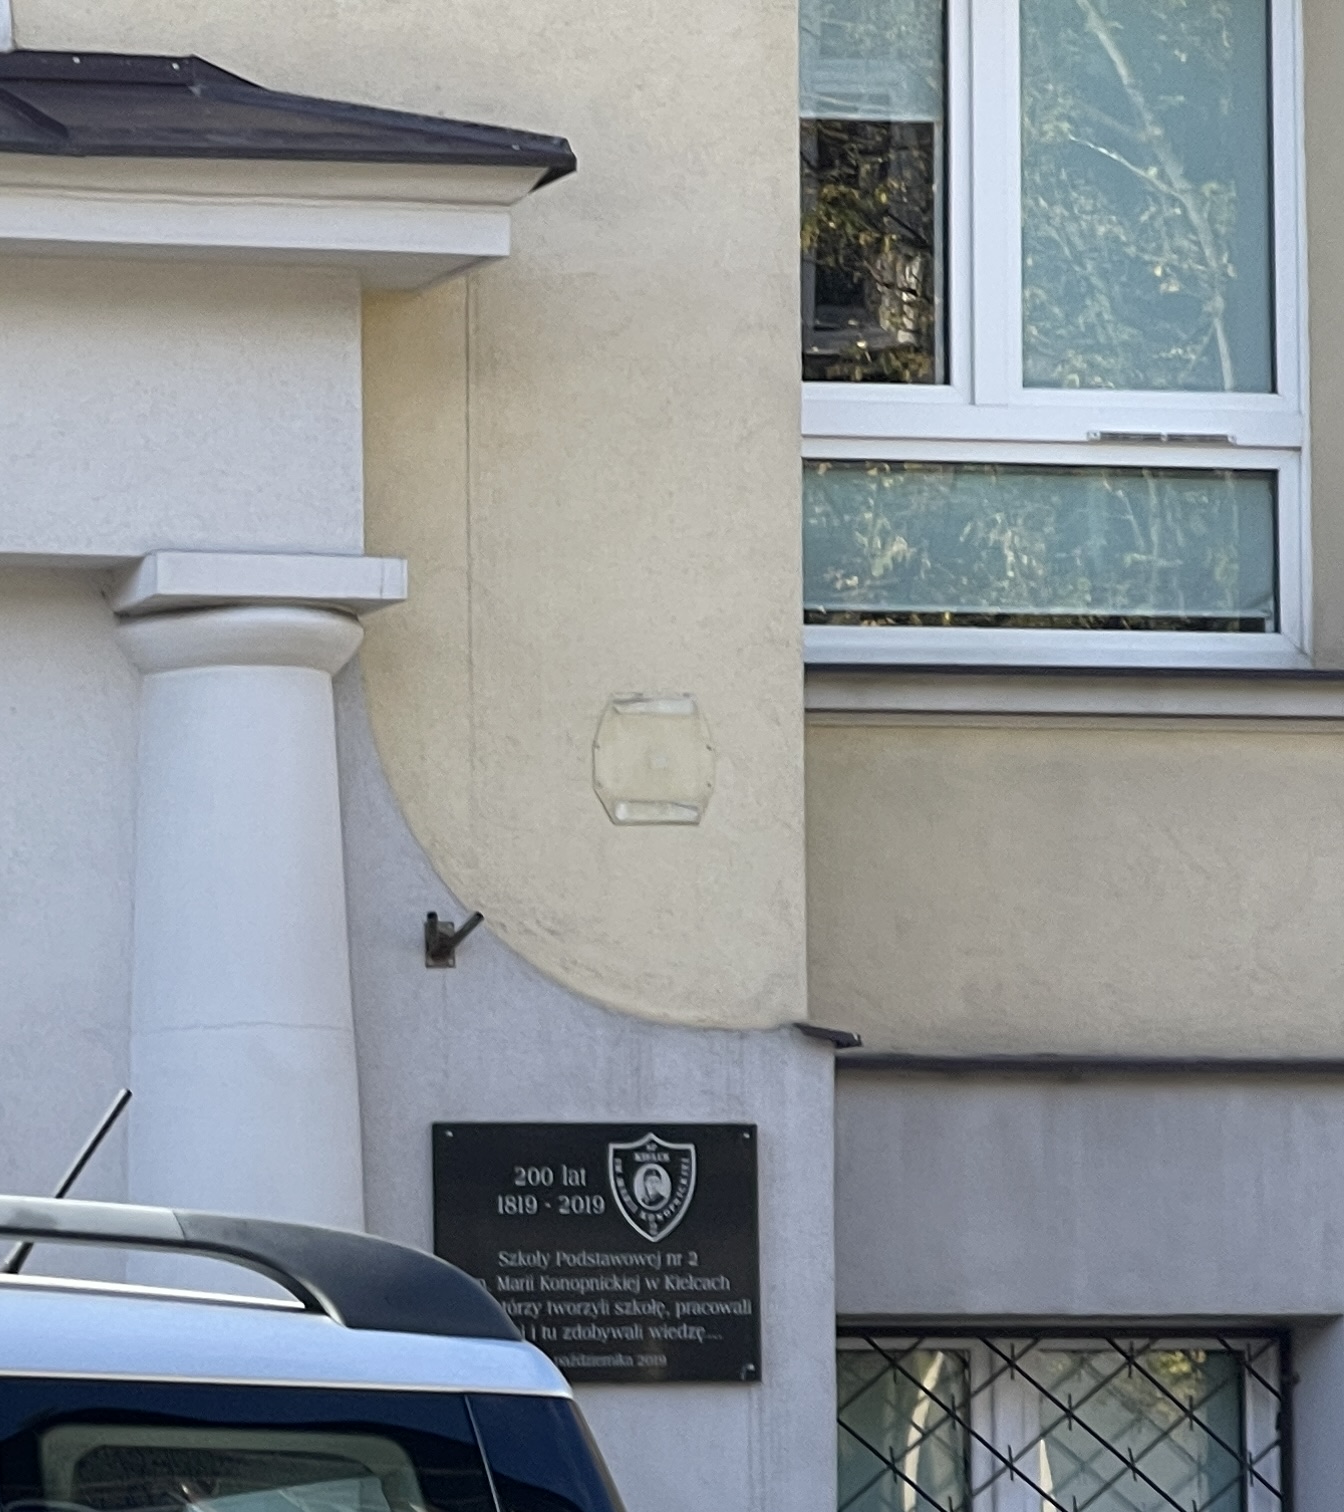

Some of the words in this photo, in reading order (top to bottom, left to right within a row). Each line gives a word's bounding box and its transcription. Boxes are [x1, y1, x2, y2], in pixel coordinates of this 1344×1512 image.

[514, 1166, 554, 1187] 200
[561, 1164, 586, 1187] lat
[497, 1194, 538, 1215] 1819
[558, 1194, 606, 1215] 2019
[556, 1250, 662, 1271] Podstawowej
[666, 1253, 682, 1267] nr
[688, 1250, 699, 1267] 2
[496, 1275, 534, 1292] Marii
[540, 1275, 641, 1295] Konopnickiej
[644, 1277, 659, 1291] w
[664, 1275, 731, 1291] Kielcach
[547, 1299, 611, 1319] tworzyli
[675, 1299, 752, 1320] pracowali
[562, 1322, 644, 1344] zdobywali
